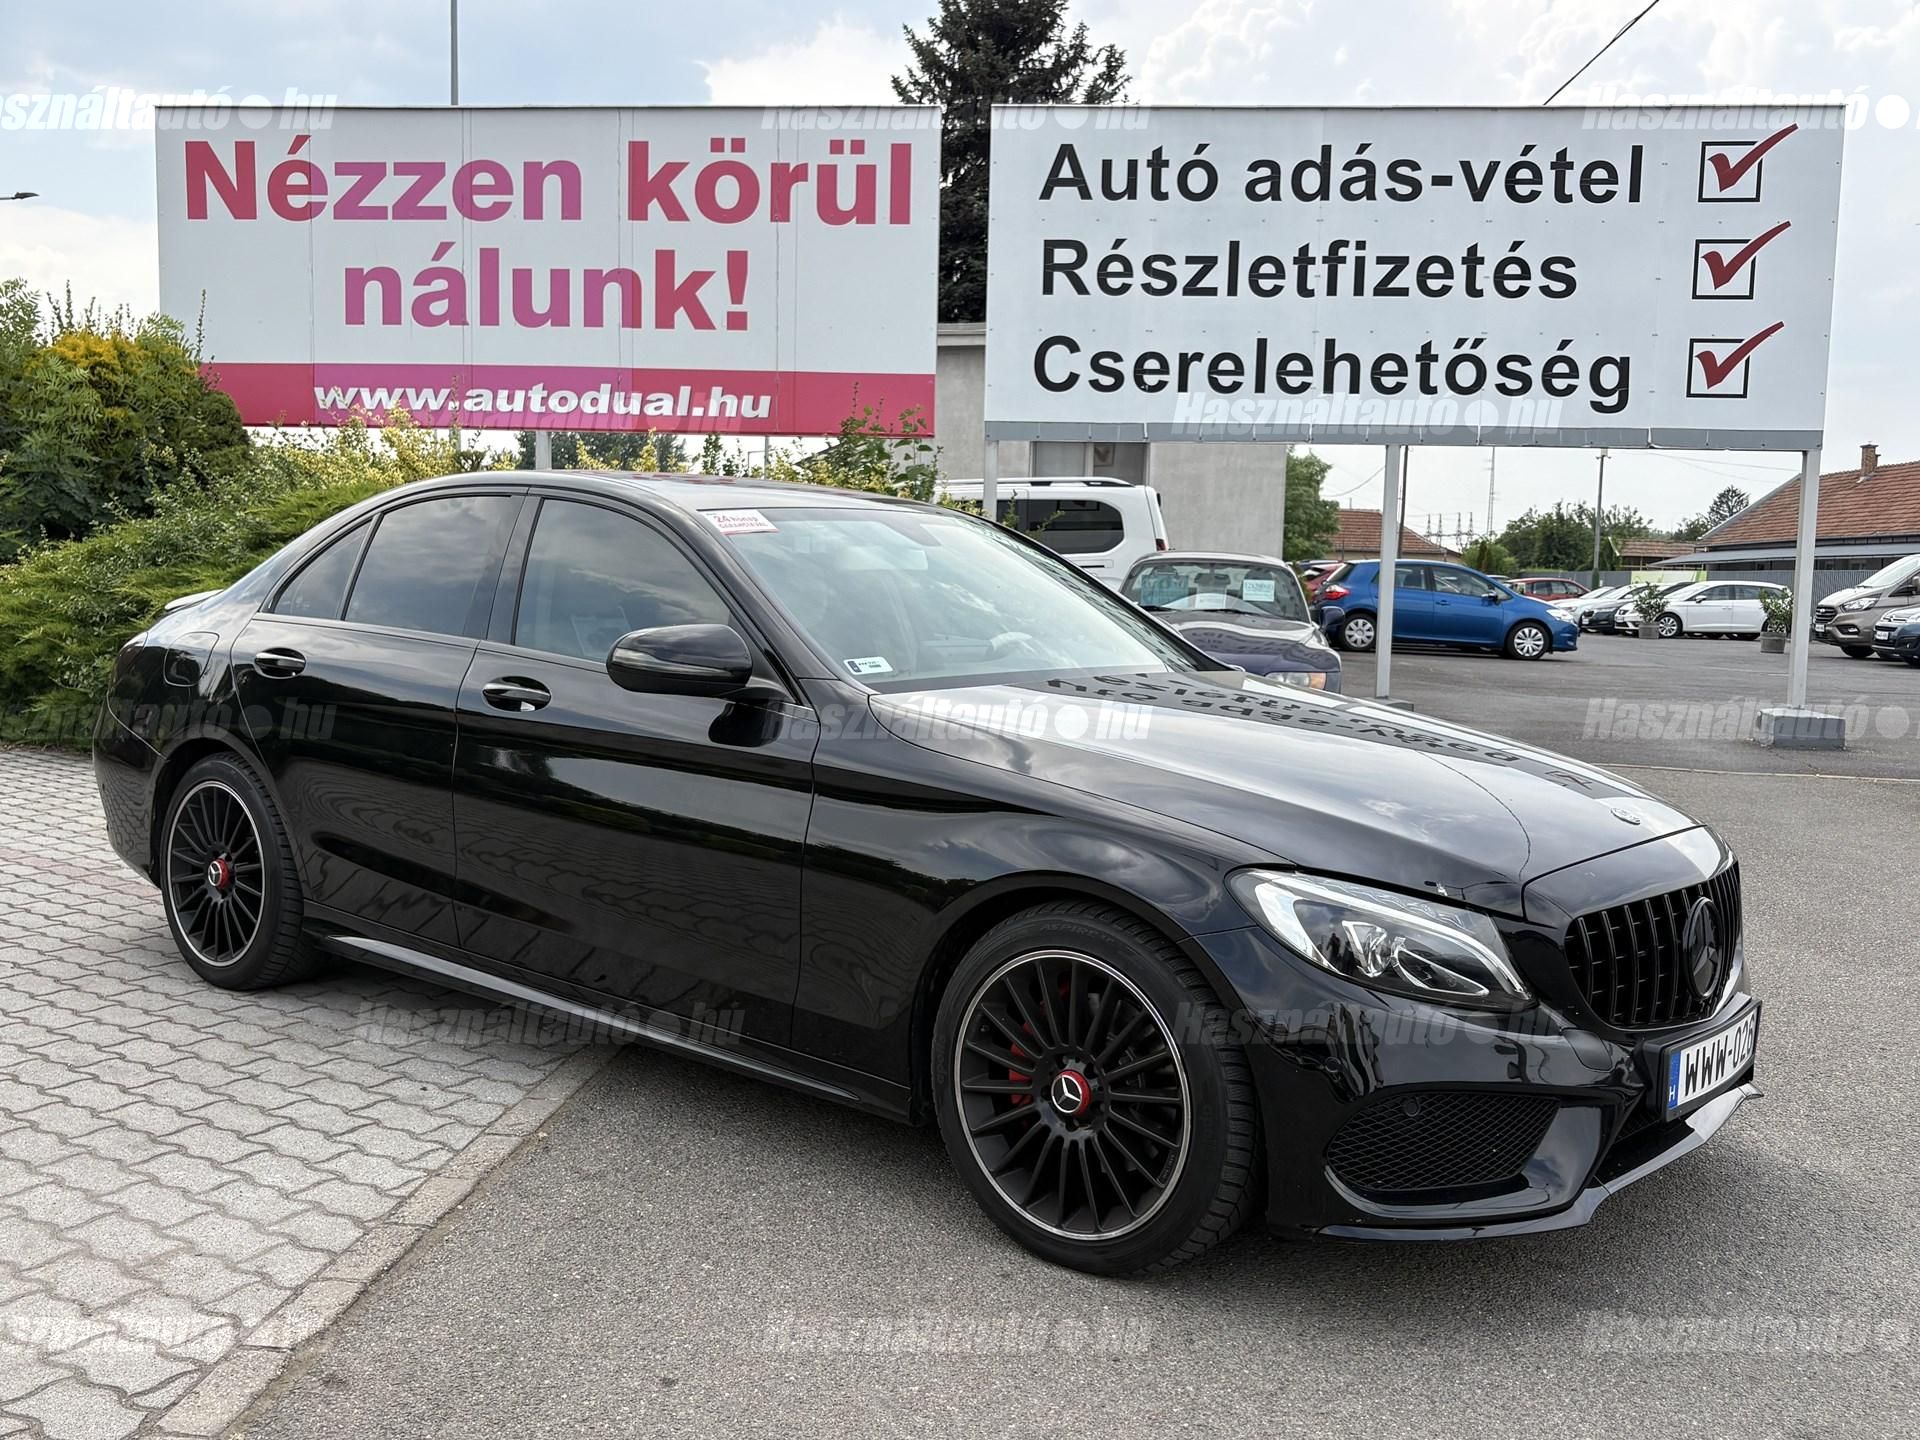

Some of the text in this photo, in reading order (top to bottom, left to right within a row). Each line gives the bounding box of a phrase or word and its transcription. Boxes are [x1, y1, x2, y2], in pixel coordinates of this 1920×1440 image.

[185, 135, 912, 226] Nézzen körül
[1040, 142, 1644, 204] Autó adás-vétel
[345, 242, 749, 331] nálunk!
[1042, 238, 1578, 299] Részletfizetés
[313, 383, 772, 419] www.autodual.hu
[1034, 335, 1631, 414] Cserelehetőség
